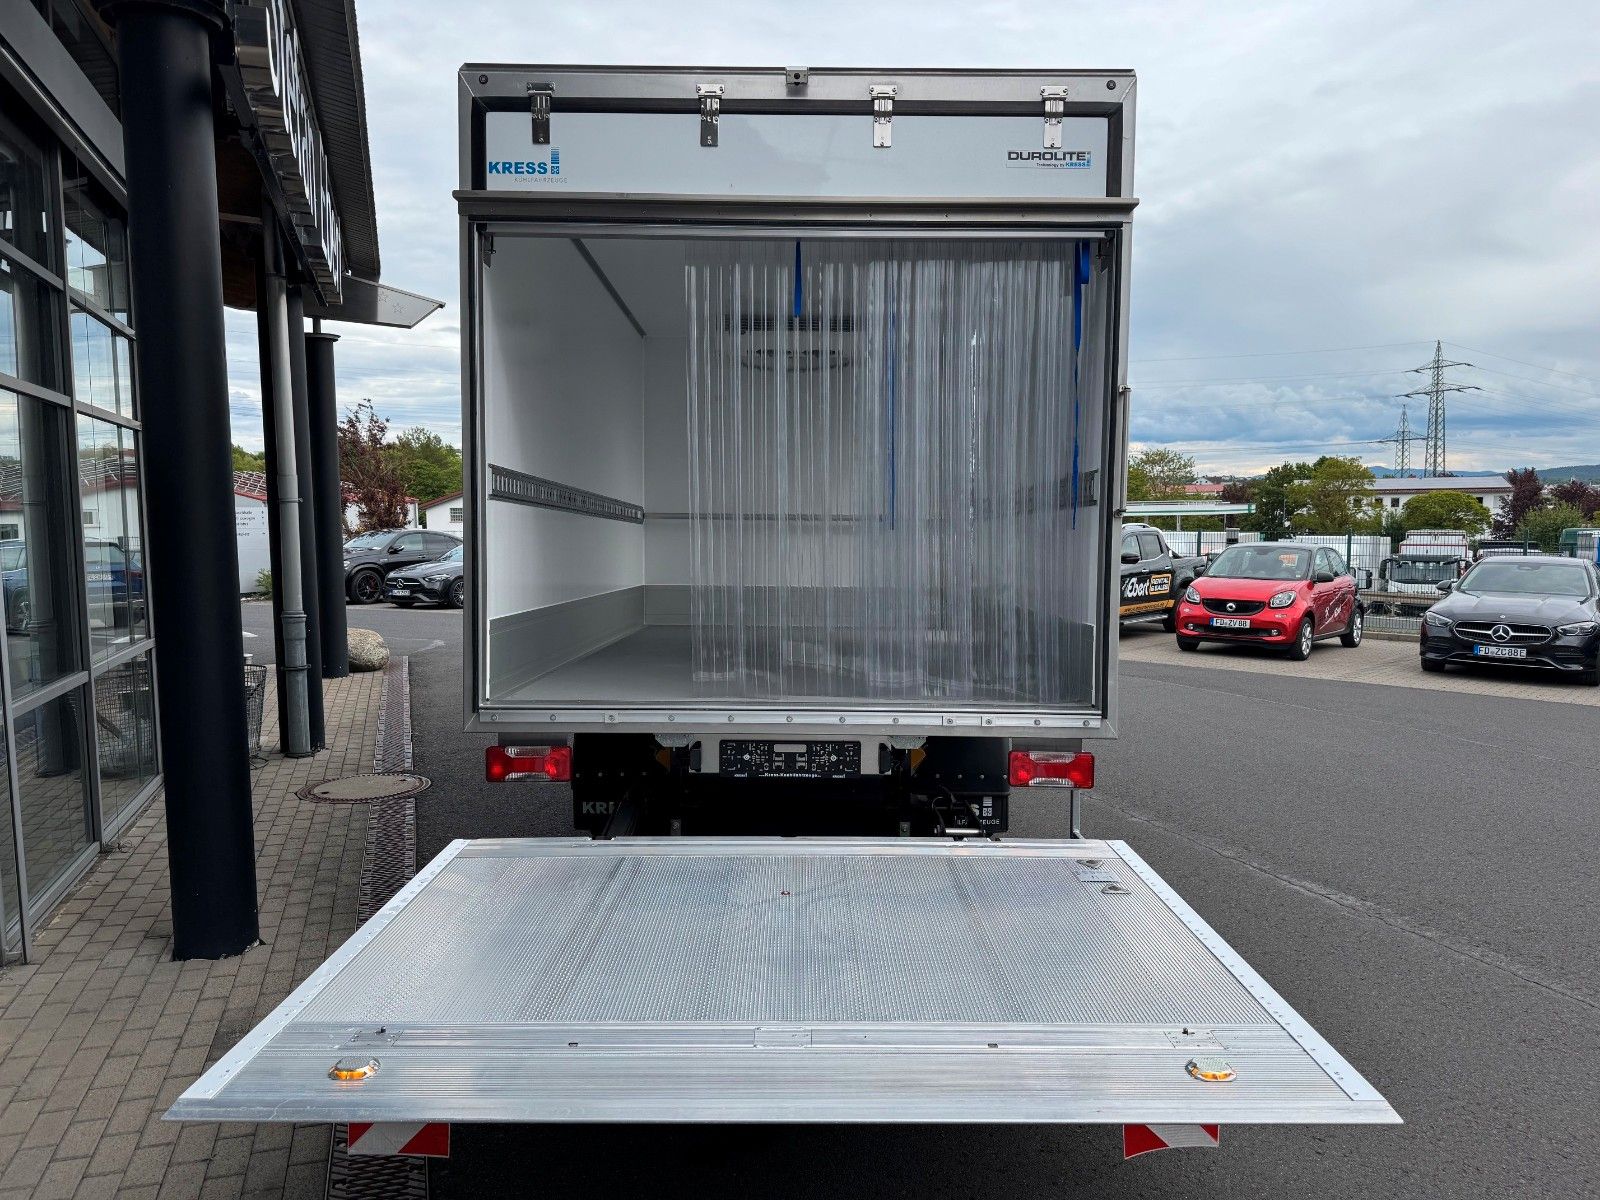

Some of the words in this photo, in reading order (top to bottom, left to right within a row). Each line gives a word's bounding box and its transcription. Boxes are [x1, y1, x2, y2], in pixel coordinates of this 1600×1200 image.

[1007, 151, 1086, 161] DUROLITE
[488, 161, 547, 175] KRESS
[1124, 577, 1149, 598] Ebert
